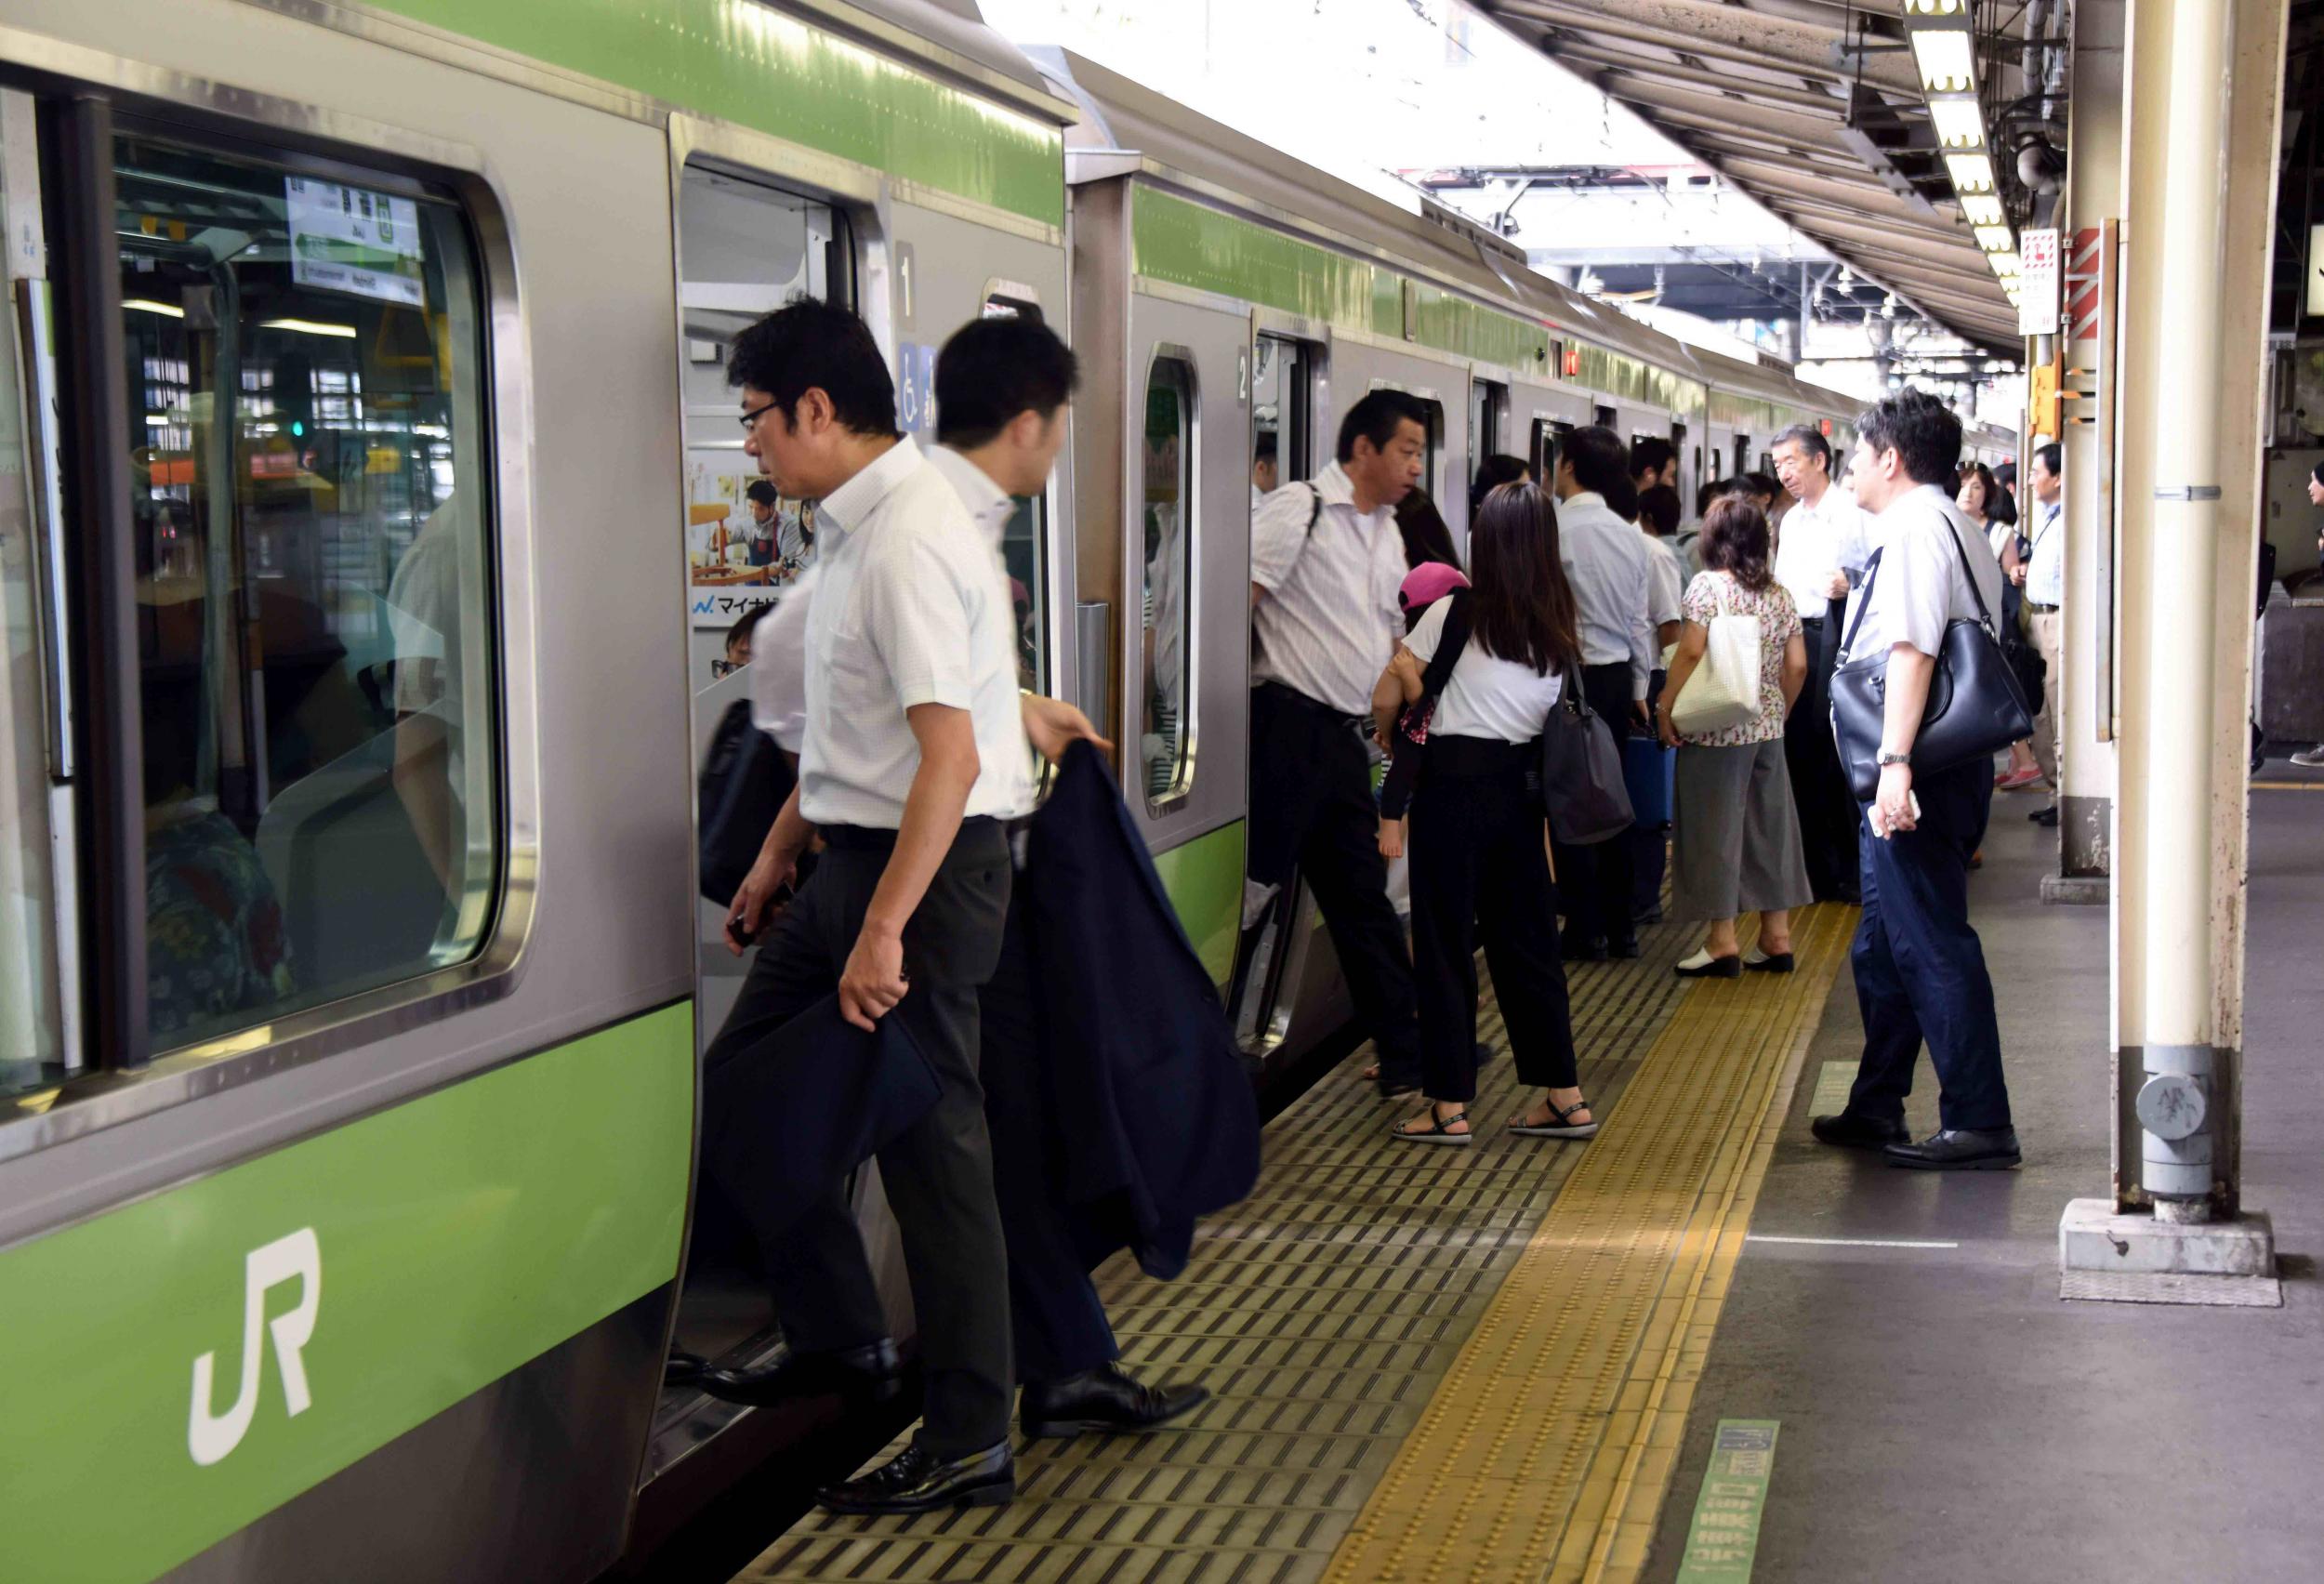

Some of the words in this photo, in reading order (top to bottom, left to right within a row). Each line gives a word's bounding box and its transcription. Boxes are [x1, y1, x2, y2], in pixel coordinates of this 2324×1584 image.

[901, 256, 910, 317] 1
[1239, 356, 1246, 399] 2
[188, 1226, 322, 1467] JR
